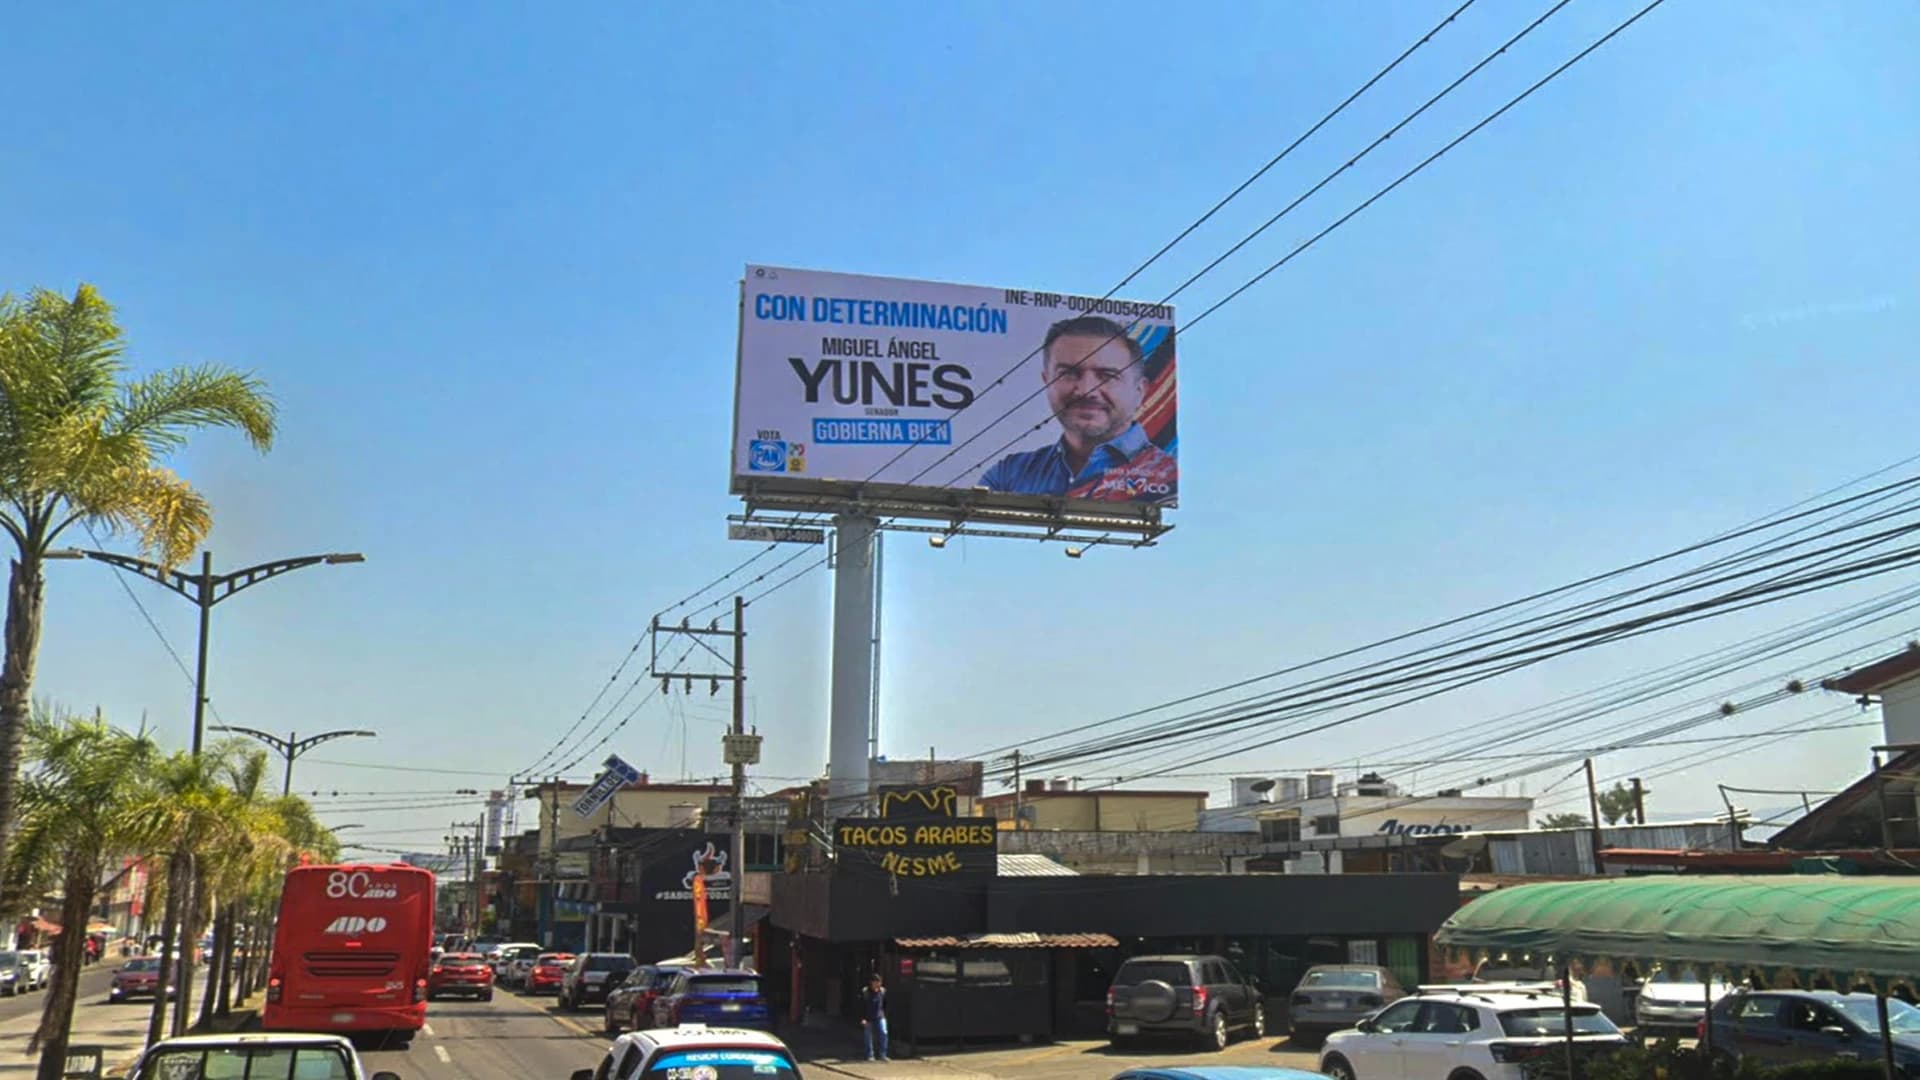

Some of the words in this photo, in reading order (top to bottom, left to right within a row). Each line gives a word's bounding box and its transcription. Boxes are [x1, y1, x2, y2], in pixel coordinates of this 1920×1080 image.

[756, 293, 805, 320] CON
[813, 296, 1007, 334] DETERMINACIÓN
[822, 337, 884, 358] MIGUEL
[887, 336, 940, 360] ÁNGEL
[788, 357, 975, 410] YUNES
[757, 430, 781, 440] VOTA
[816, 421, 904, 443] GOBIERNA
[908, 424, 949, 443] BIEN
[575, 773, 619, 815] TORNILLOS
[840, 826, 908, 846] TACOS
[913, 826, 993, 845] ARABES
[881, 851, 963, 877] NESME
[326, 871, 369, 898] 80
[324, 916, 387, 933] ADO
